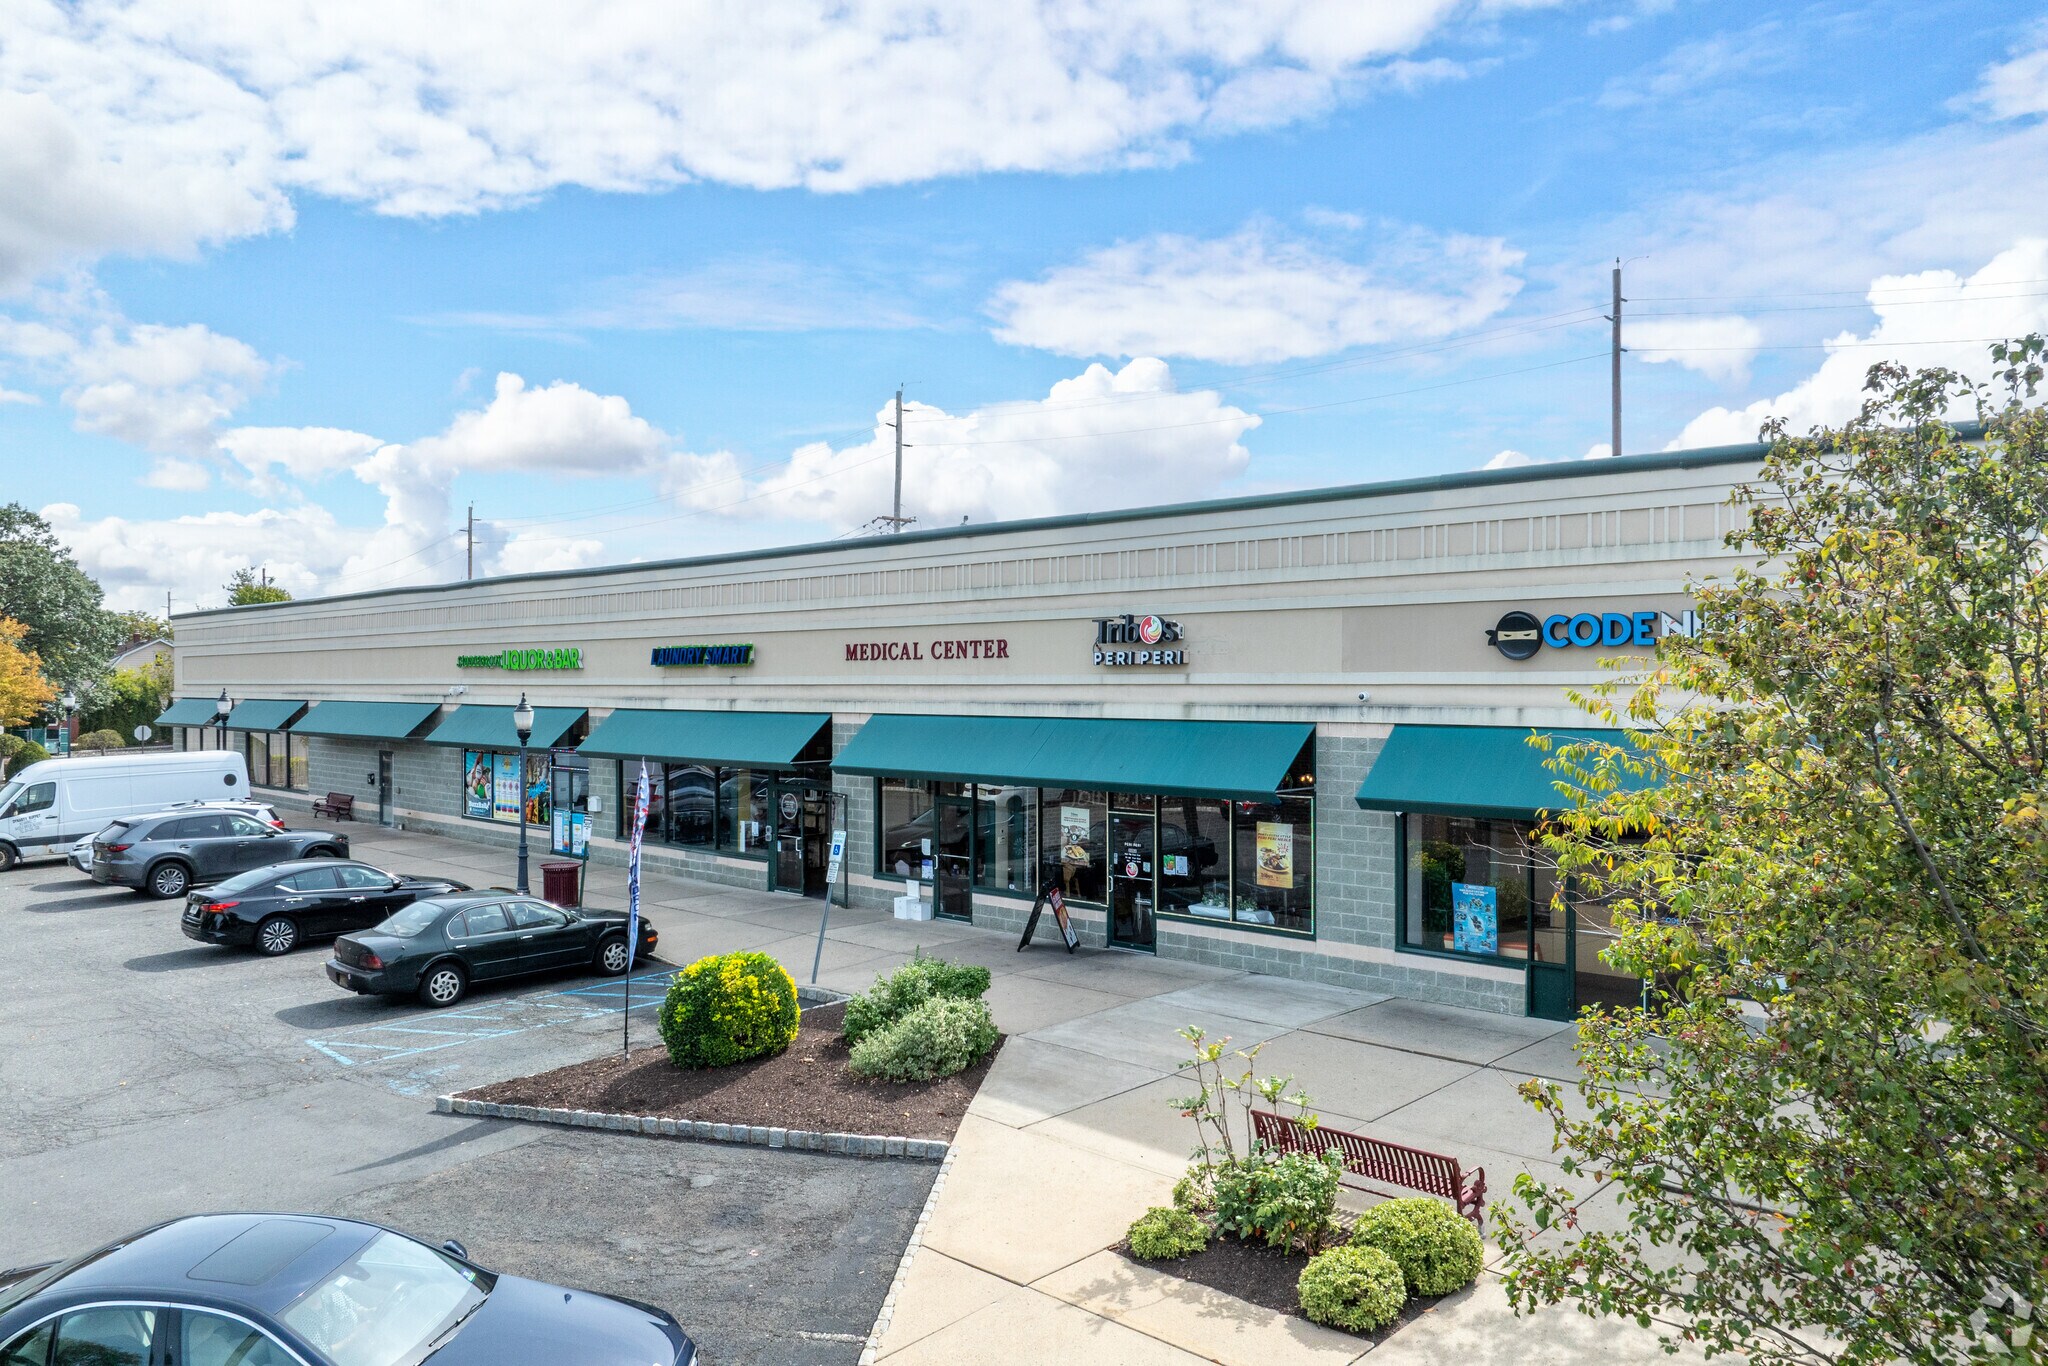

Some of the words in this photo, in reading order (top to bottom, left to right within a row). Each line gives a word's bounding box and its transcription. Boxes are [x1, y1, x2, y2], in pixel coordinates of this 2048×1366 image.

[1542, 611, 1657, 649] CODE
[554, 648, 582, 669] BAR
[650, 646, 703, 666] LAUNDRY
[704, 645, 750, 665] SMART
[845, 642, 923, 661] MEDICAL
[930, 639, 1009, 660] CENTER
[1093, 650, 1134, 666] PERI
[1140, 649, 1183, 665] PERI
